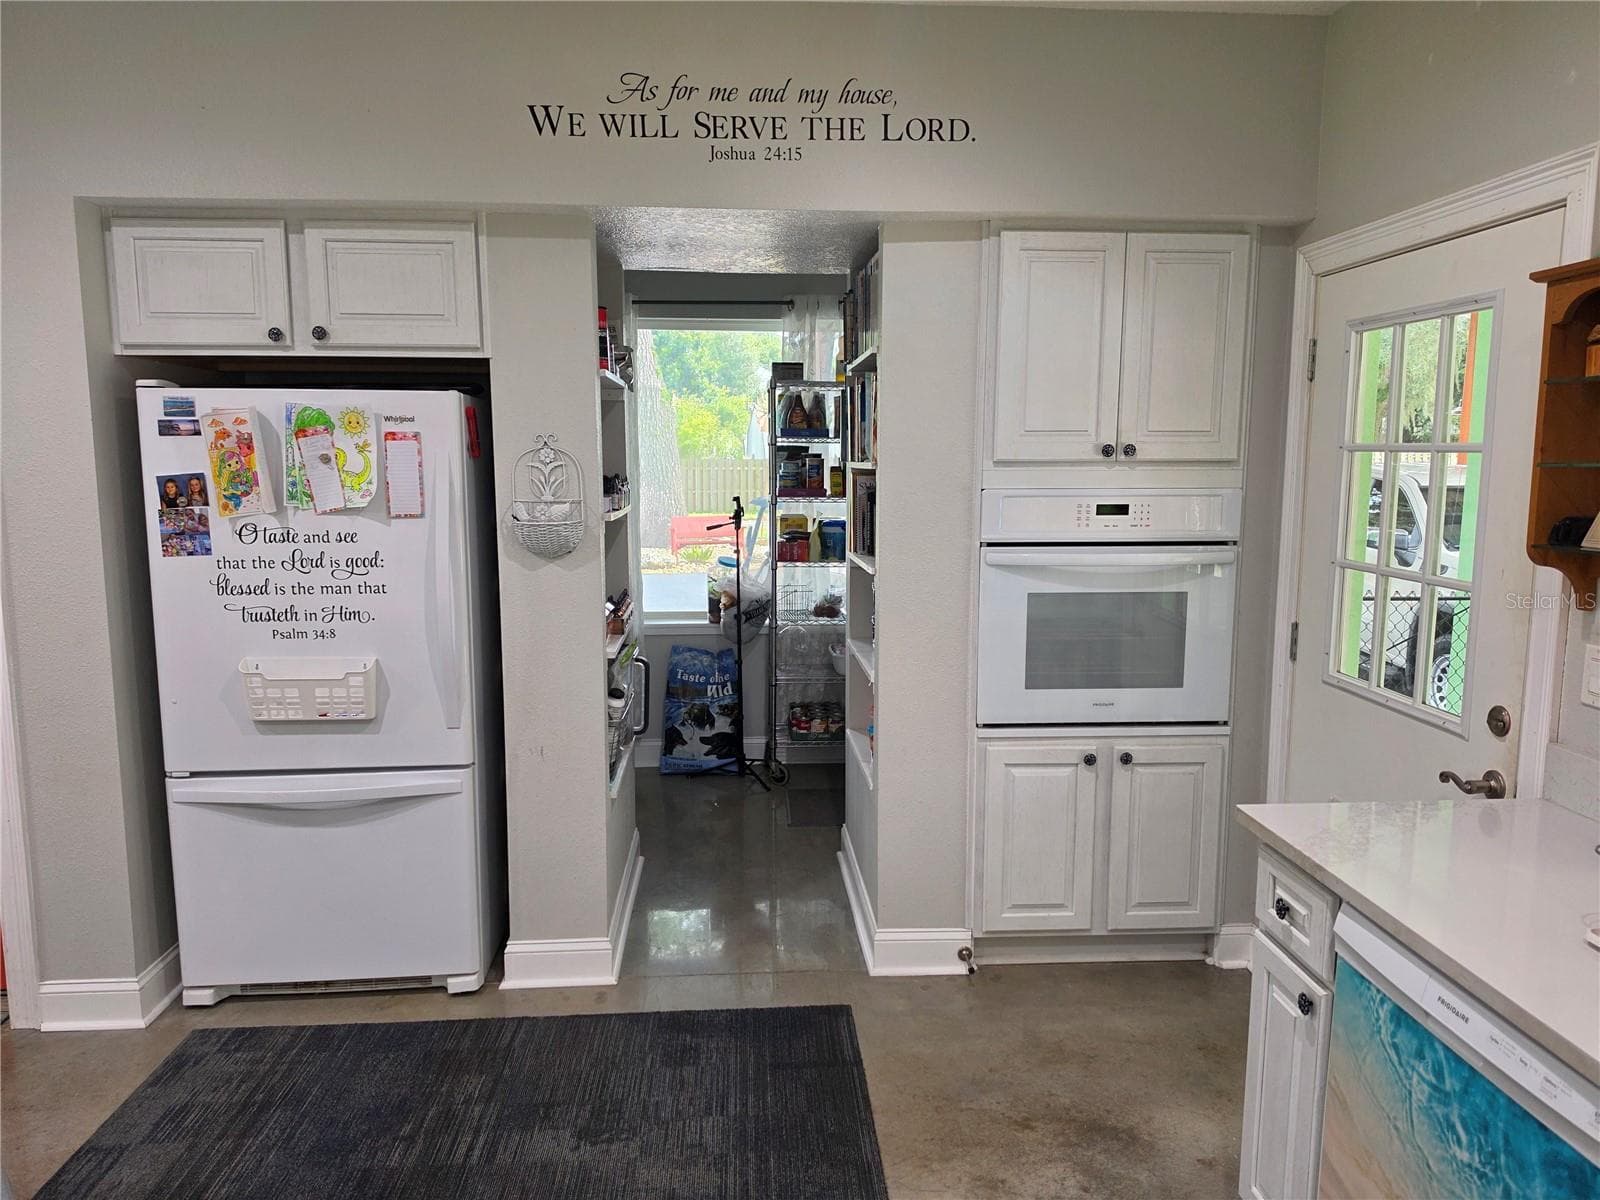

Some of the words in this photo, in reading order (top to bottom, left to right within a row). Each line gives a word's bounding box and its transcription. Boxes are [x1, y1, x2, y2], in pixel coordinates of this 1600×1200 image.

[606, 73, 659, 104] As
[656, 74, 700, 111] for
[708, 87, 739, 103] me
[749, 78, 793, 104] and
[798, 89, 830, 115] my
[838, 78, 897, 108] house,
[801, 116, 867, 142] THE
[708, 145, 757, 163] Joshua
[763, 146, 803, 162] 24:15
[233, 522, 259, 546] O
[257, 525, 300, 545] taste
[303, 529, 331, 544] and
[334, 531, 359, 544] see
[216, 555, 248, 570] that
[251, 555, 276, 570] the
[281, 548, 327, 575] Lord
[329, 554, 342, 569] is
[331, 550, 385, 581] good:
[208, 573, 272, 597] blessed
[274, 582, 287, 596] is
[290, 581, 316, 596] the
[319, 584, 352, 596] man
[357, 580, 388, 595] that
[223, 602, 301, 624] trusteth
[303, 608, 318, 622] in
[320, 604, 376, 624] Him.
[271, 627, 309, 640] Psalm
[312, 628, 337, 640] 34:8
[677, 668, 706, 682] Taste
[1438, 996, 1468, 1024] FRIGIDAIRE
